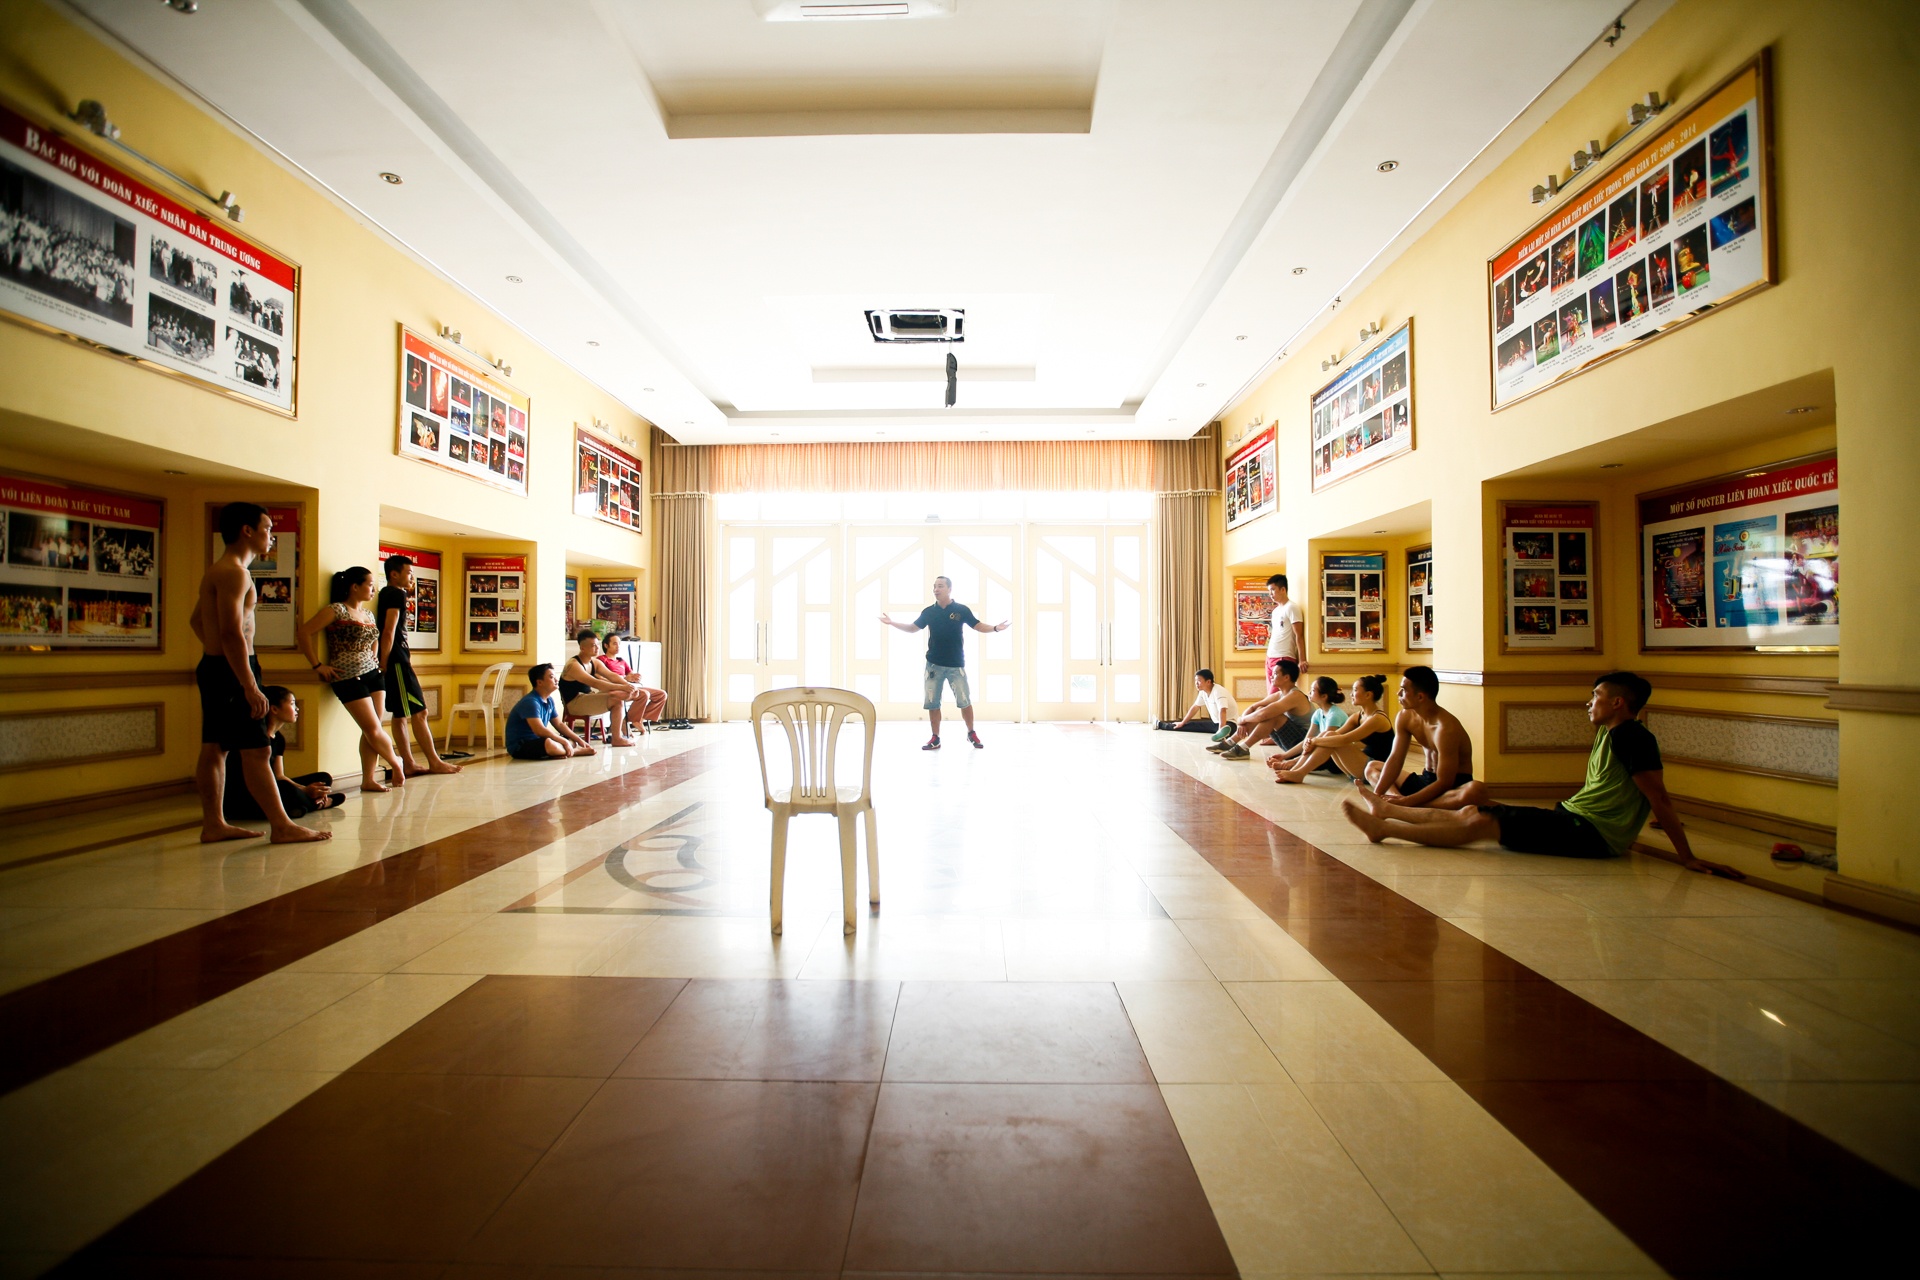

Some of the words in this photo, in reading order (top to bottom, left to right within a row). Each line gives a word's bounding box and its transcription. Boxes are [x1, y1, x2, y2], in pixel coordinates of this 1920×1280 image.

[1582, 201, 1594, 215] MỤC
[1605, 178, 1622, 197] TRONG
[1622, 167, 1636, 184] THỜI
[1636, 157, 1650, 175] GIAN
[1679, 122, 1697, 143] 2014
[80, 163, 100, 184] VỚI
[102, 176, 132, 201] ĐOÀN
[134, 193, 159, 215] XIẾC
[160, 207, 187, 231] NHÂN
[189, 223, 208, 242] DÂN
[209, 233, 238, 258] TRUNG
[239, 250, 261, 270] ƯƠNG
[1, 486, 18, 501] VỚI
[20, 490, 42, 504] LIÊN
[44, 495, 69, 509] ĐOÀN
[71, 498, 91, 512] XIẾC
[93, 503, 112, 516] VIỆT
[113, 506, 131, 519] NAM
[1669, 502, 1685, 515] MỘT
[1686, 496, 1696, 511] SỐ
[1696, 494, 1725, 509] POSTER
[1726, 488, 1745, 503] LIÊN
[1747, 485, 1770, 500] HOAN
[1771, 477, 1793, 495] XIẾC
[1794, 472, 1820, 490] QUỐC
